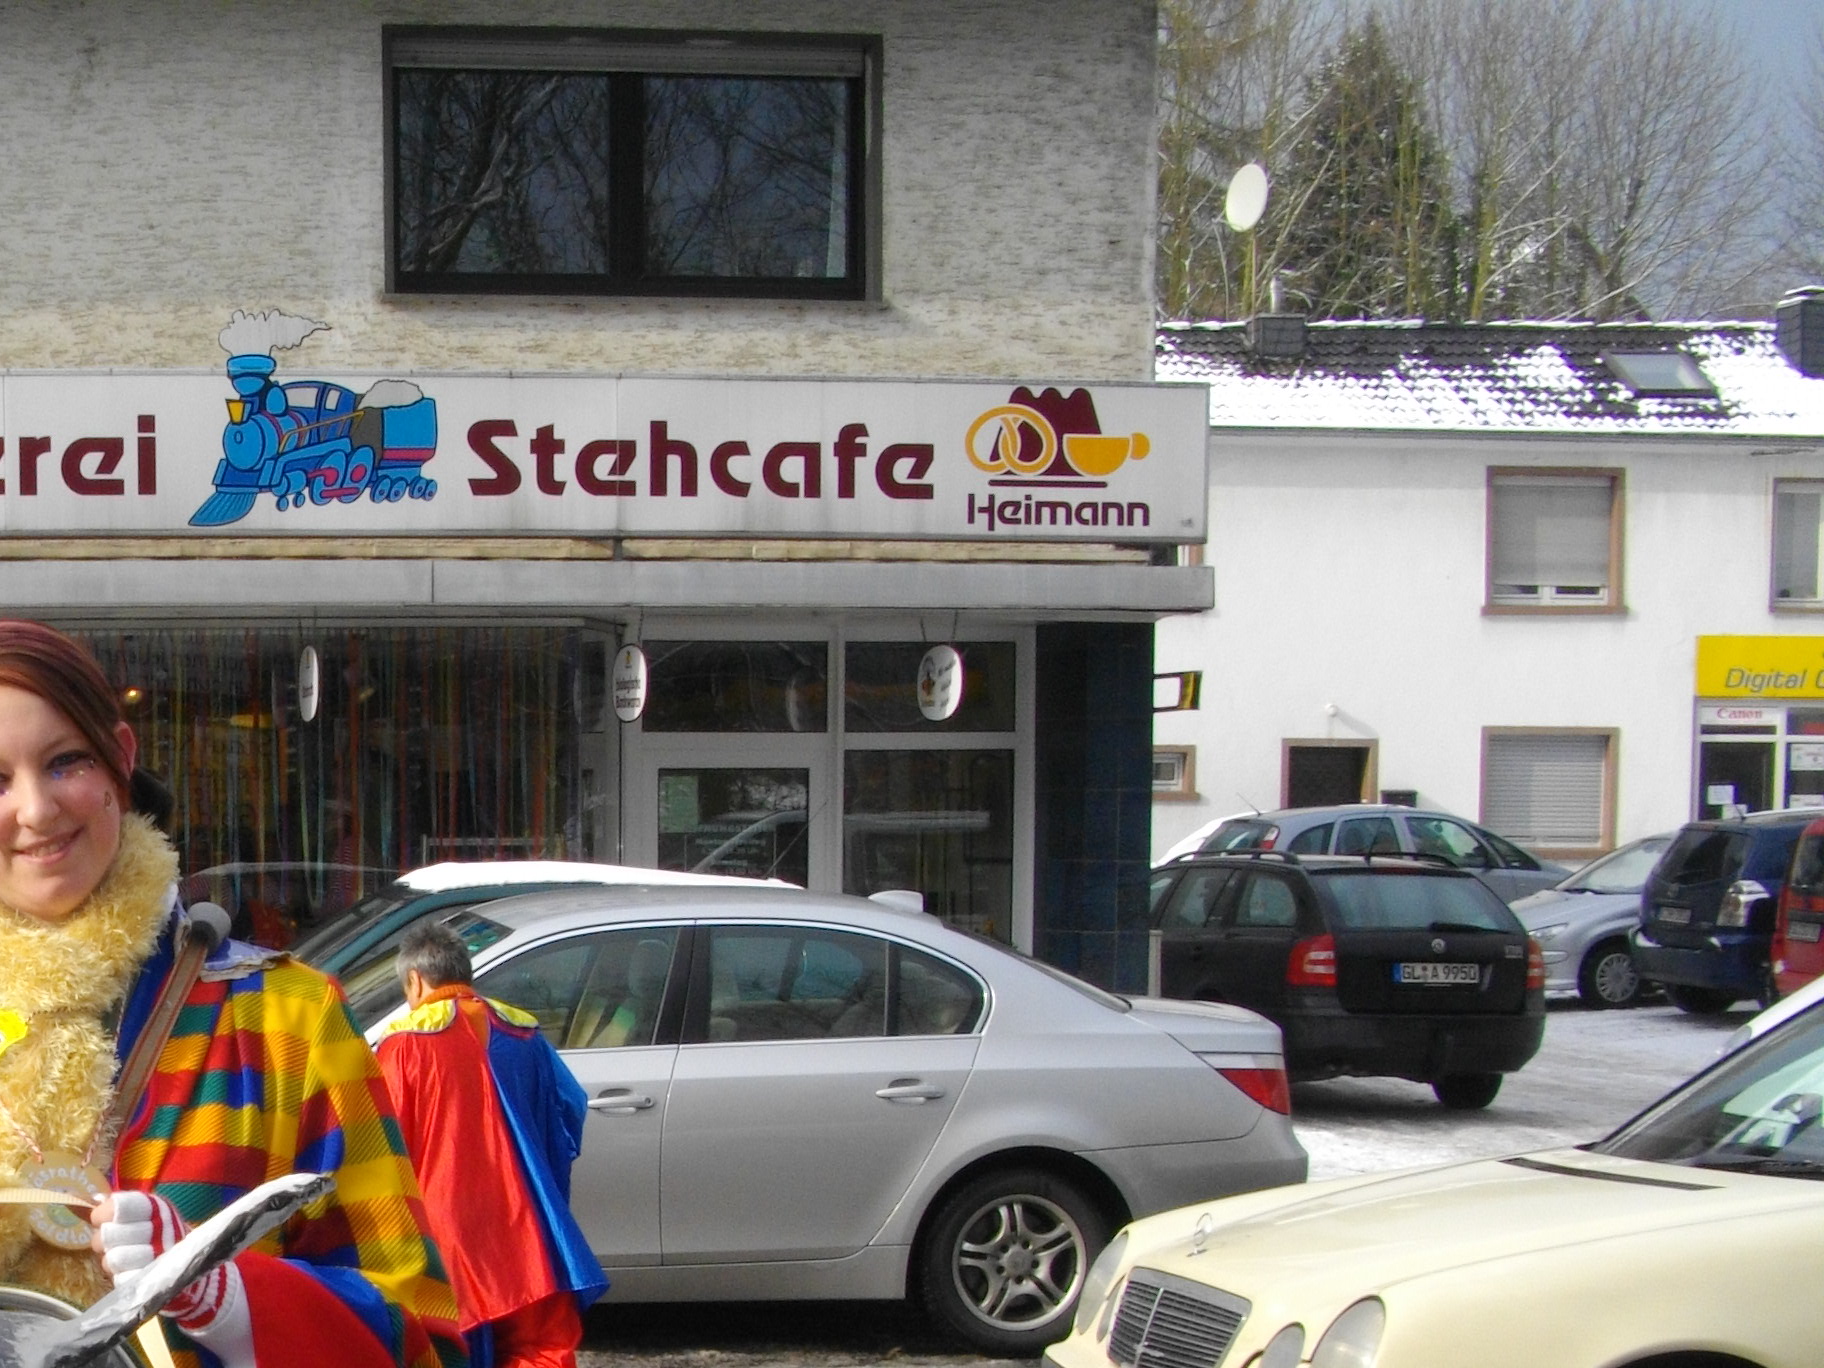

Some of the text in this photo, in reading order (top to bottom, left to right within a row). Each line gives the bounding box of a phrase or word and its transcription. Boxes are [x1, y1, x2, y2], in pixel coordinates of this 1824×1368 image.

[466, 419, 933, 500] Stehcafe
[967, 493, 1150, 531] Heimann
[1725, 668, 1807, 692] Digital
[1716, 706, 1763, 720] Canon
